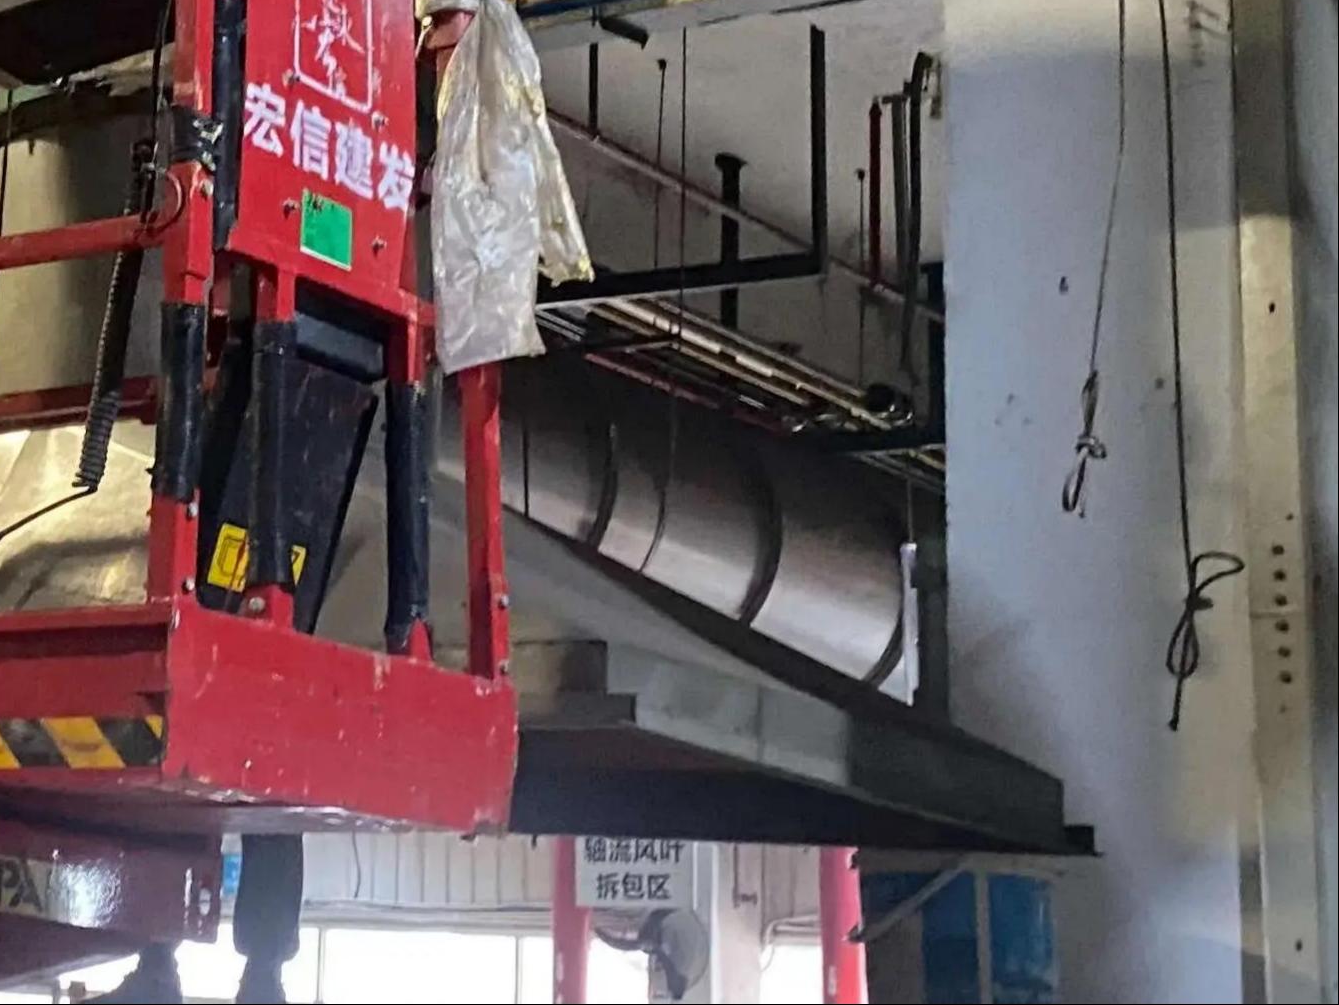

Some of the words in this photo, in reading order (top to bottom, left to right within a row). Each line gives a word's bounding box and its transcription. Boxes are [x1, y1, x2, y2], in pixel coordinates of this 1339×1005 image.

[243, 82, 413, 210] 宏信建发
[596, 871, 670, 900] 拆包区
